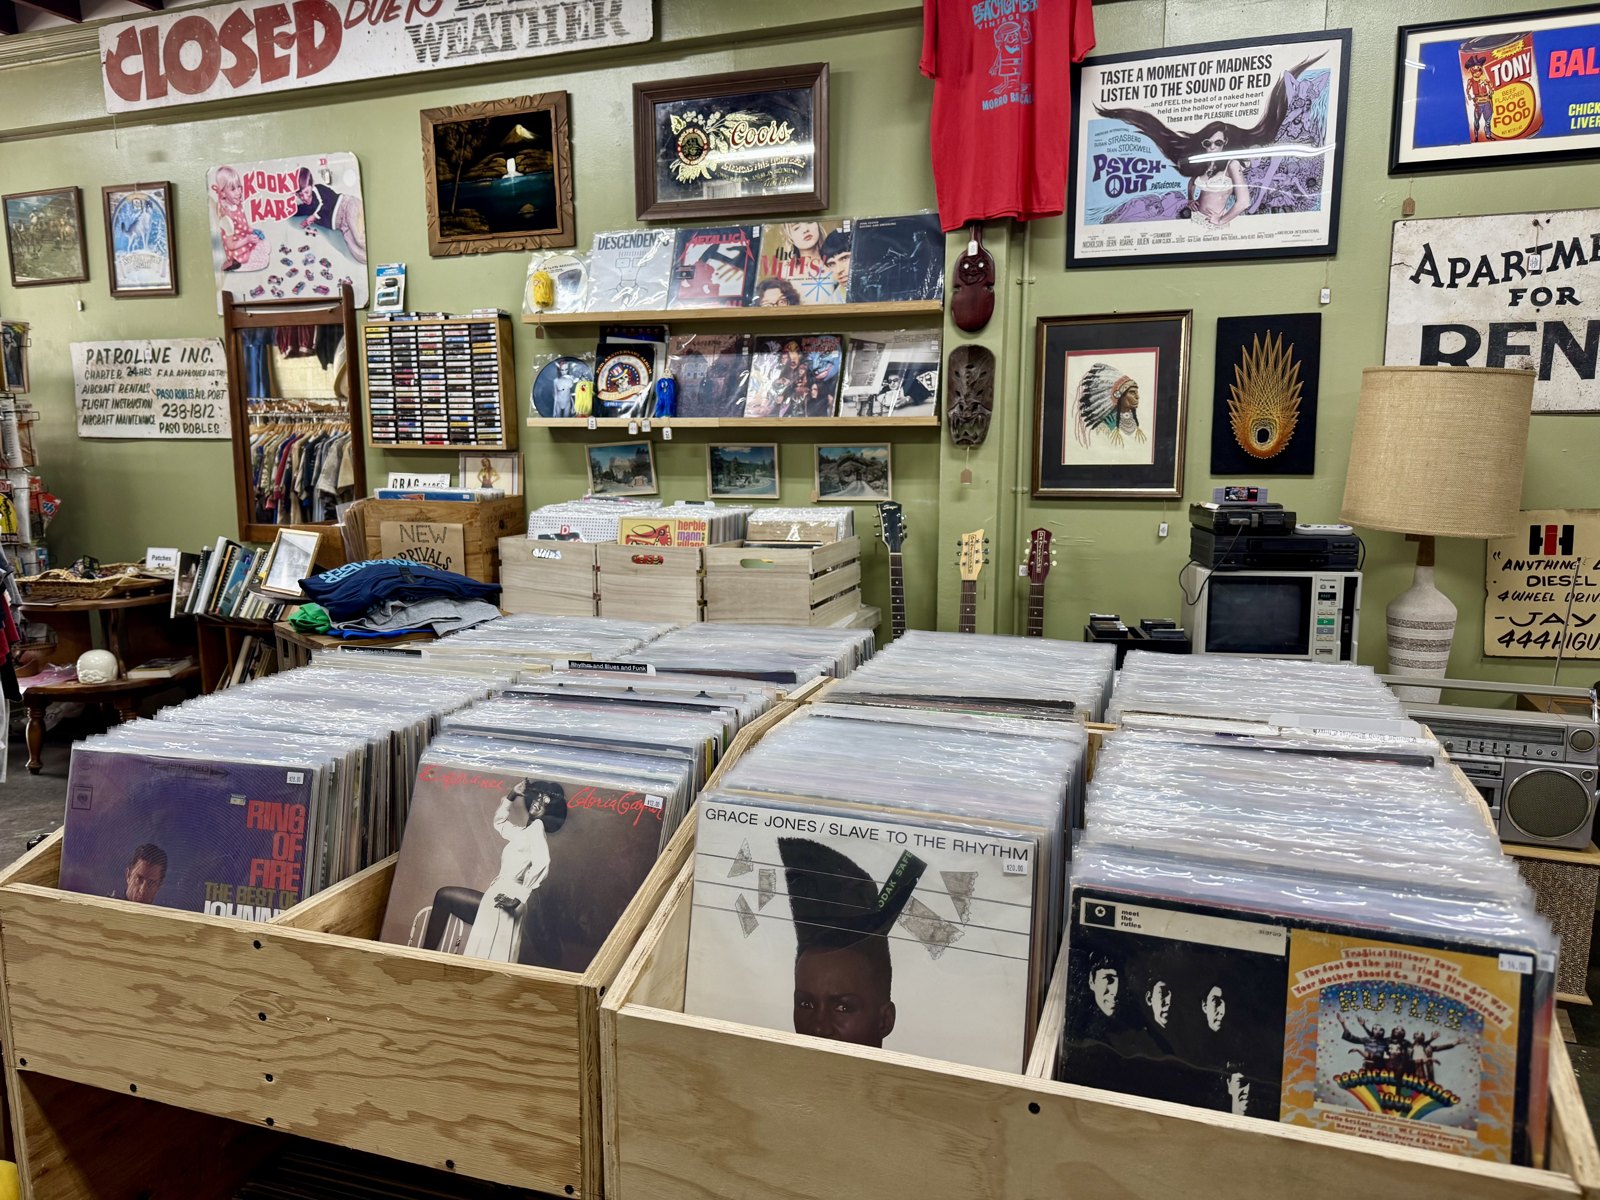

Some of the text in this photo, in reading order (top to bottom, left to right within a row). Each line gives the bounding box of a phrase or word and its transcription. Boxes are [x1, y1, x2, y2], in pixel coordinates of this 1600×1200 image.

[343, 0, 400, 29] DUE
[978, 14, 1019, 30] VINTAGE
[405, 0, 630, 63] WEATHER
[105, 0, 342, 101] CLOSED
[1100, 54, 1272, 85] TASTE A MOMENT OF MADNESS
[1491, 52, 1531, 86] TONY
[1101, 73, 1271, 103] LISTEN TO THE SOUND OF RED
[1246, 91, 1264, 99] heart
[1502, 87, 1517, 97] BEEF
[982, 94, 1008, 110] MORRO
[1192, 103, 1214, 111] hollow
[1224, 102, 1239, 110] your
[1496, 98, 1526, 116] DOG
[1167, 115, 1182, 123] These
[1194, 113, 1203, 121] the
[1204, 111, 1233, 120] PLEASURE
[1494, 108, 1531, 128] FOOD
[731, 120, 792, 148] Coors
[1118, 144, 1152, 153] STOCKWELL
[243, 168, 299, 200] KOOKY
[1105, 174, 1154, 198] OUT
[250, 196, 298, 224] KARS
[775, 247, 796, 260] the
[1508, 286, 1583, 307] FOR
[180, 347, 213, 364] INC.
[84, 369, 123, 380] CHARTER
[81, 382, 151, 394] AIRCRAFT RENTALS
[156, 388, 174, 400] PASO
[81, 397, 153, 410] FLIGHT INSTRUCTION
[161, 402, 215, 420] 238-1812
[81, 414, 115, 426] AIRCRAFT
[159, 422, 220, 434] PASO ROBLES
[400, 524, 447, 544] NEW
[1527, 575, 1597, 588] DIESEL
[247, 800, 306, 834] RING
[705, 807, 759, 826] GRACE
[764, 814, 817, 834] JONES
[828, 822, 879, 842] SLAVE
[886, 830, 908, 845] TO
[913, 834, 947, 851] THE
[952, 838, 1028, 861] RHYTHM
[272, 831, 304, 861] OF
[895, 850, 913, 878] SAFE
[1006, 863, 1024, 873] $20.00
[249, 858, 301, 892] FIRE
[204, 882, 299, 910] THE BEST OF
[1121, 909, 1139, 917] meet
[1357, 970, 1391, 979] Should
